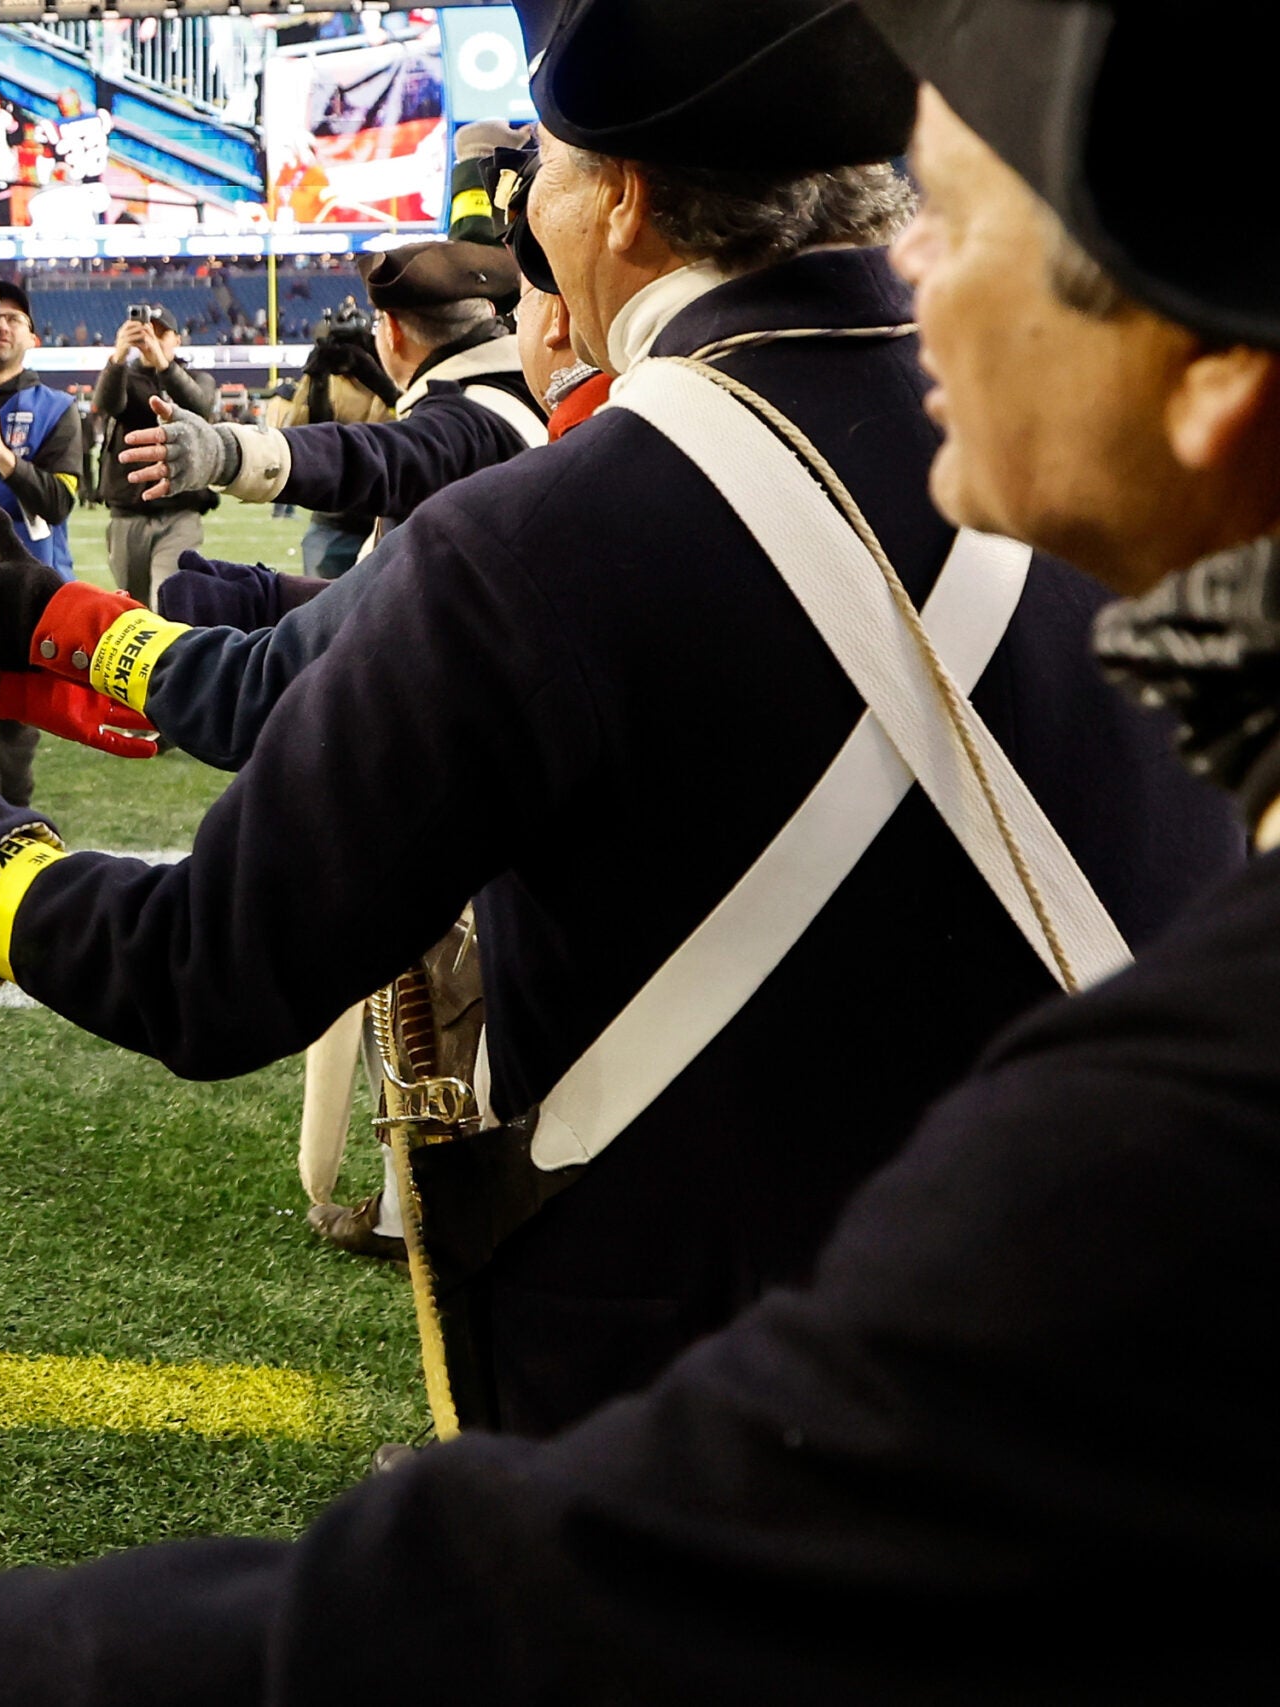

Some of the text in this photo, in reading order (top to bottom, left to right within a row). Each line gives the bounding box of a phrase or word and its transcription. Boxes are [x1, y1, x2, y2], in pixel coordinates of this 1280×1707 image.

[103, 646, 118, 671] Field
[113, 630, 158, 703] WEEK 17
[139, 663, 150, 680] NE
[28, 853, 52, 866] NE
